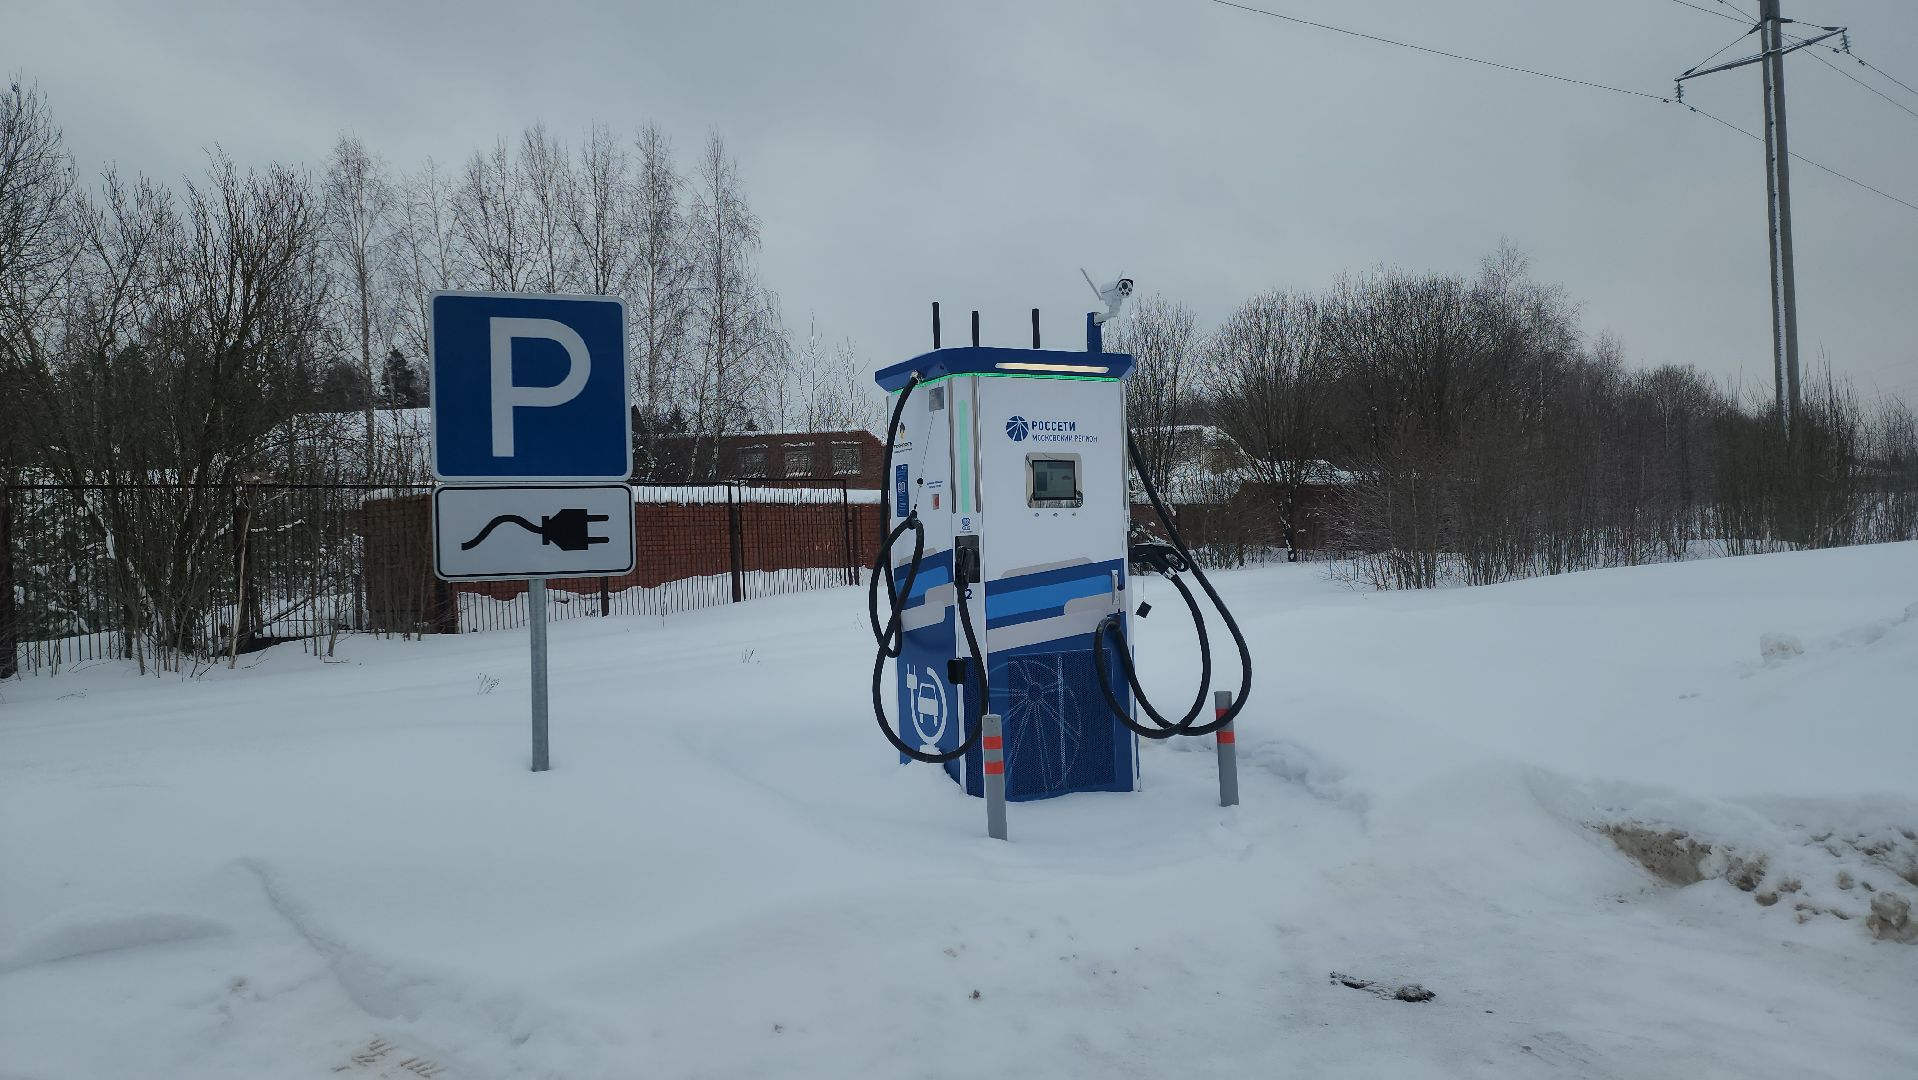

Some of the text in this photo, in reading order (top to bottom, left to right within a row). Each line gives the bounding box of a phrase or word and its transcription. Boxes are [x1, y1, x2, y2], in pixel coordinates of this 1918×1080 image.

[489, 316, 592, 458] P
[1031, 420, 1076, 432] РОССЕТИ
[1074, 435, 1098, 443] РЕГИОН
[965, 588, 973, 600] 2
